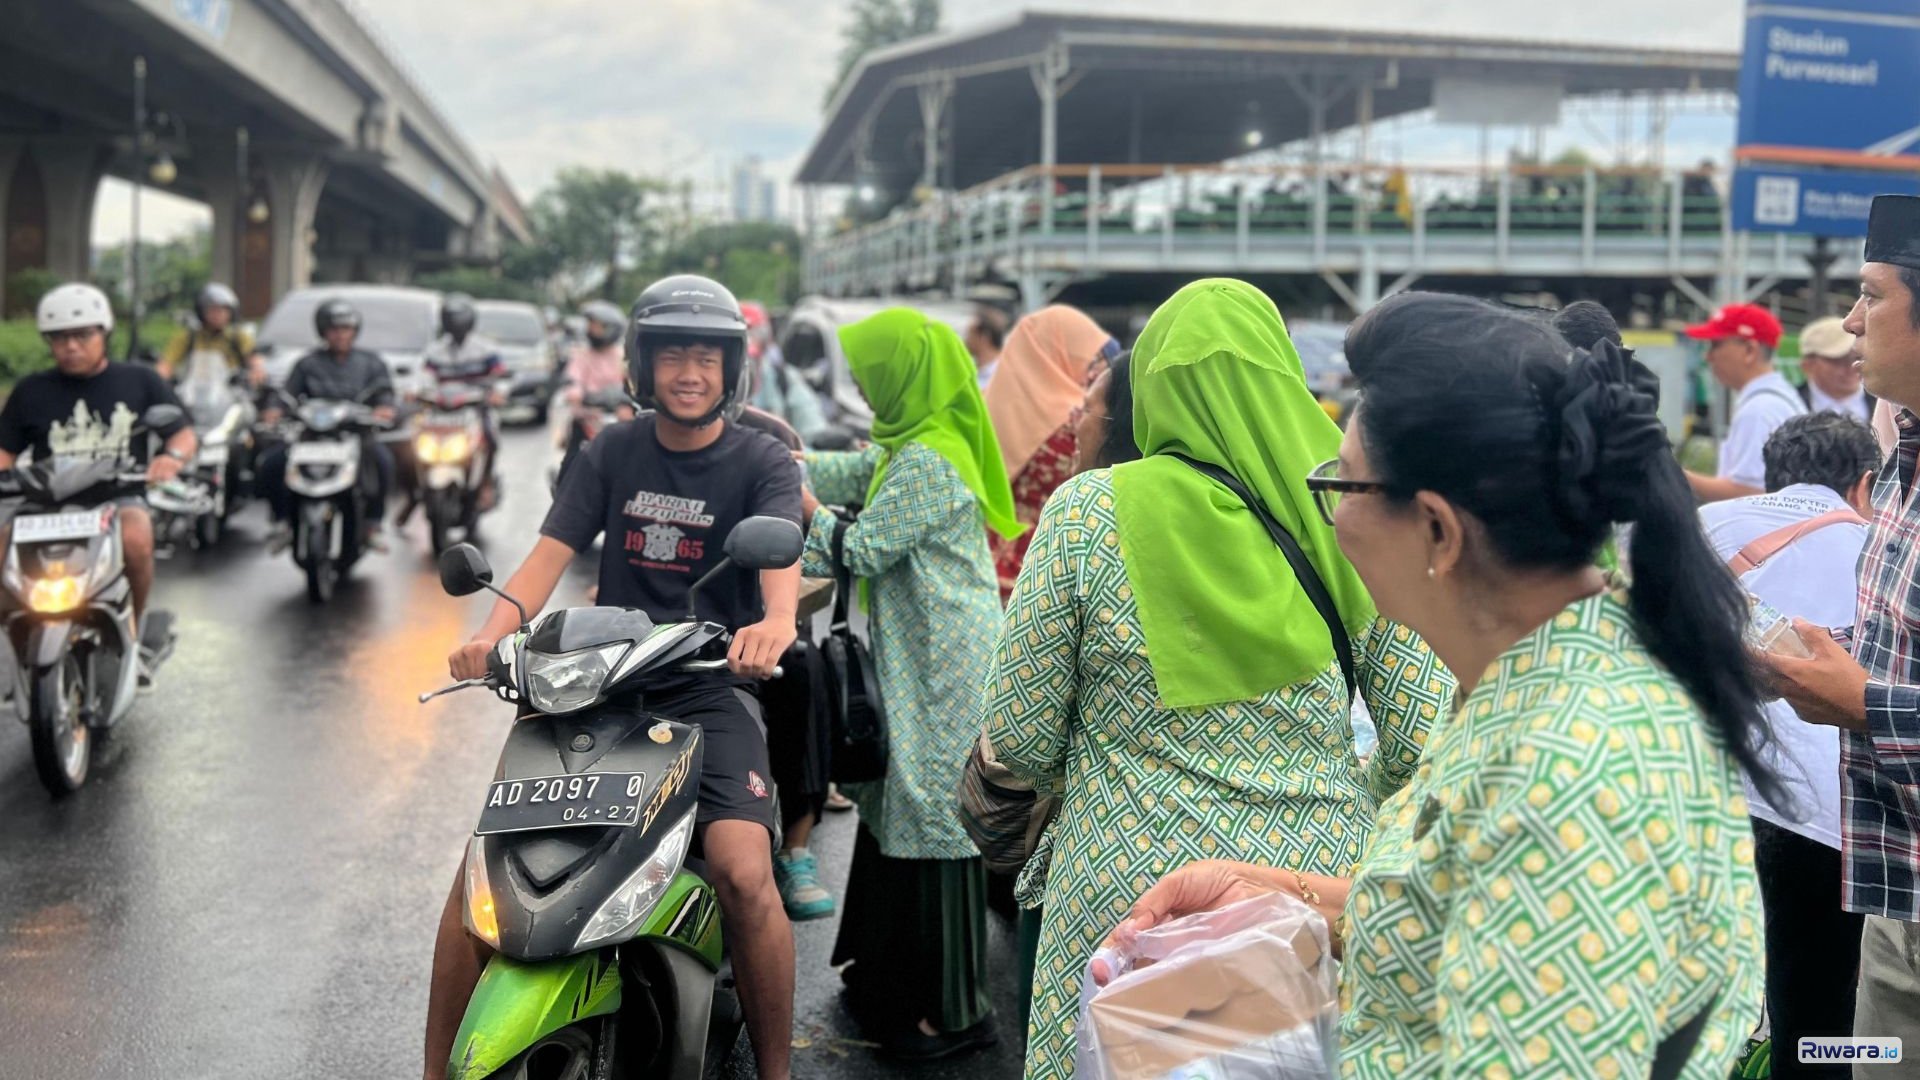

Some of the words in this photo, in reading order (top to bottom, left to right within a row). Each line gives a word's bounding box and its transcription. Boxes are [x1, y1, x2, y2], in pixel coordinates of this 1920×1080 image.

[624, 530, 644, 552] 19
[677, 539, 704, 560] 65
[488, 782, 524, 808] AD
[530, 776, 601, 803] 2097
